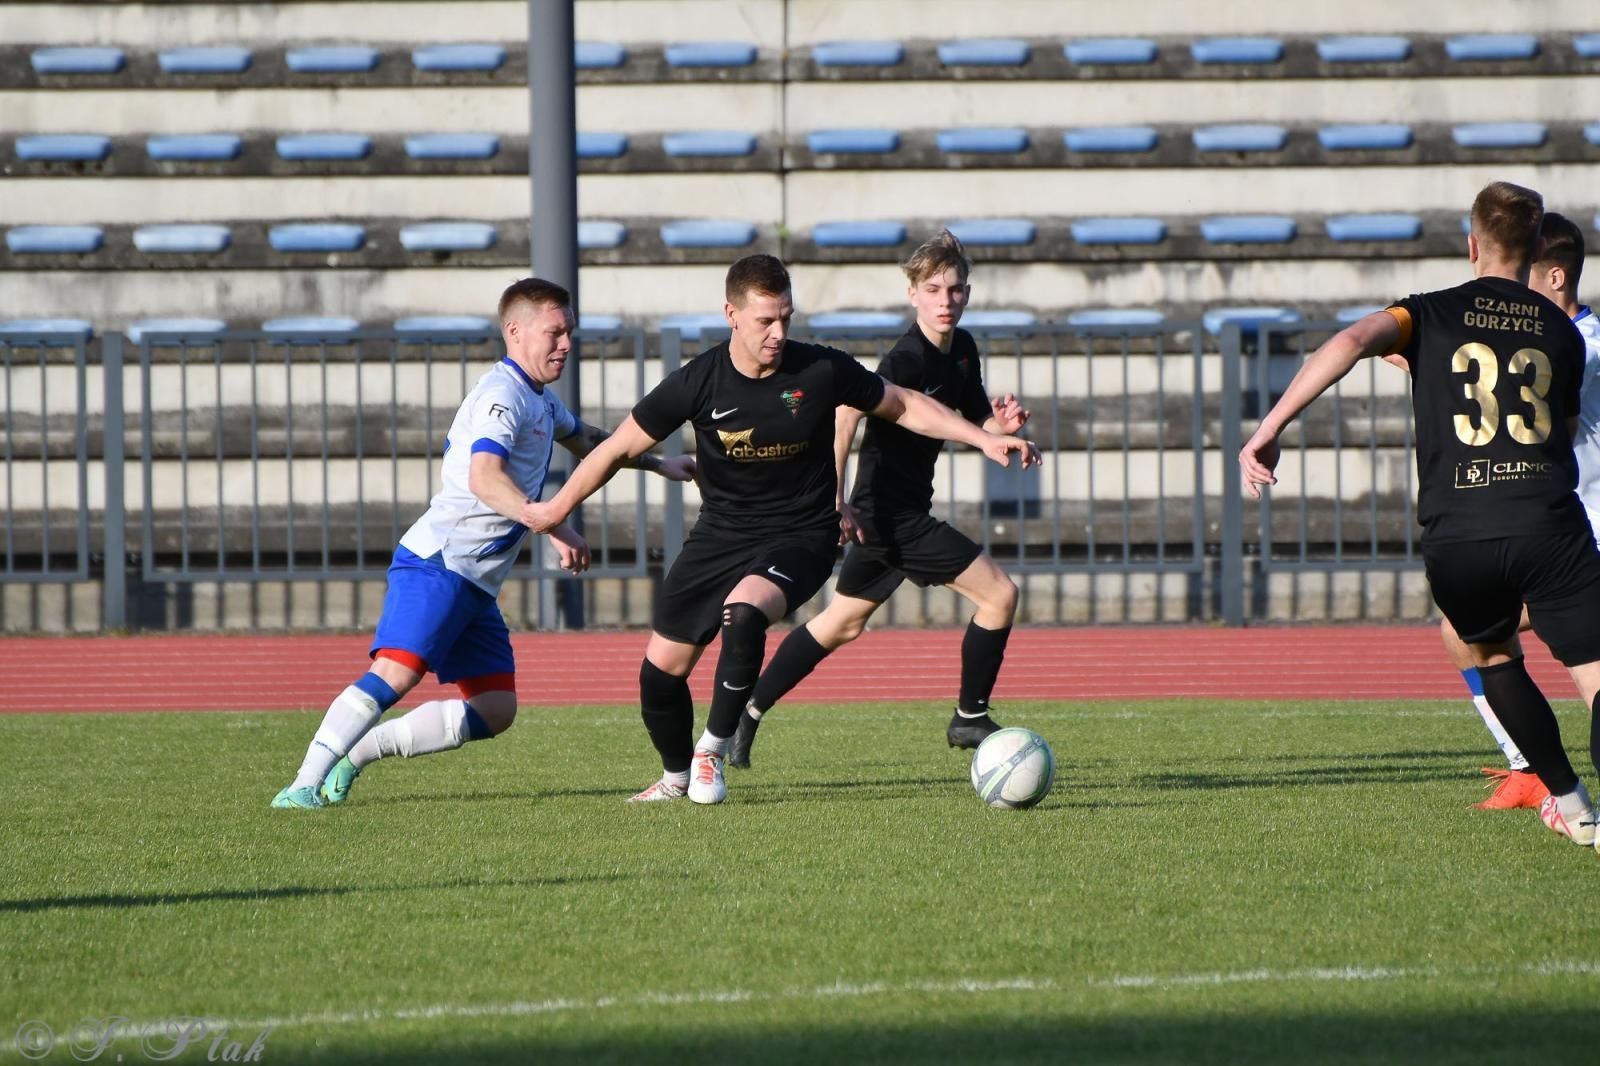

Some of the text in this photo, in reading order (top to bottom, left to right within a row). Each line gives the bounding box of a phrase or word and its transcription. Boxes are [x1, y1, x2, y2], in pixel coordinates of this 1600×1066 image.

[1474, 296, 1540, 318] CZARNI
[1463, 311, 1545, 336] GORZYCE
[1451, 342, 1553, 447] 33
[1493, 461, 1553, 473] CLINIC
